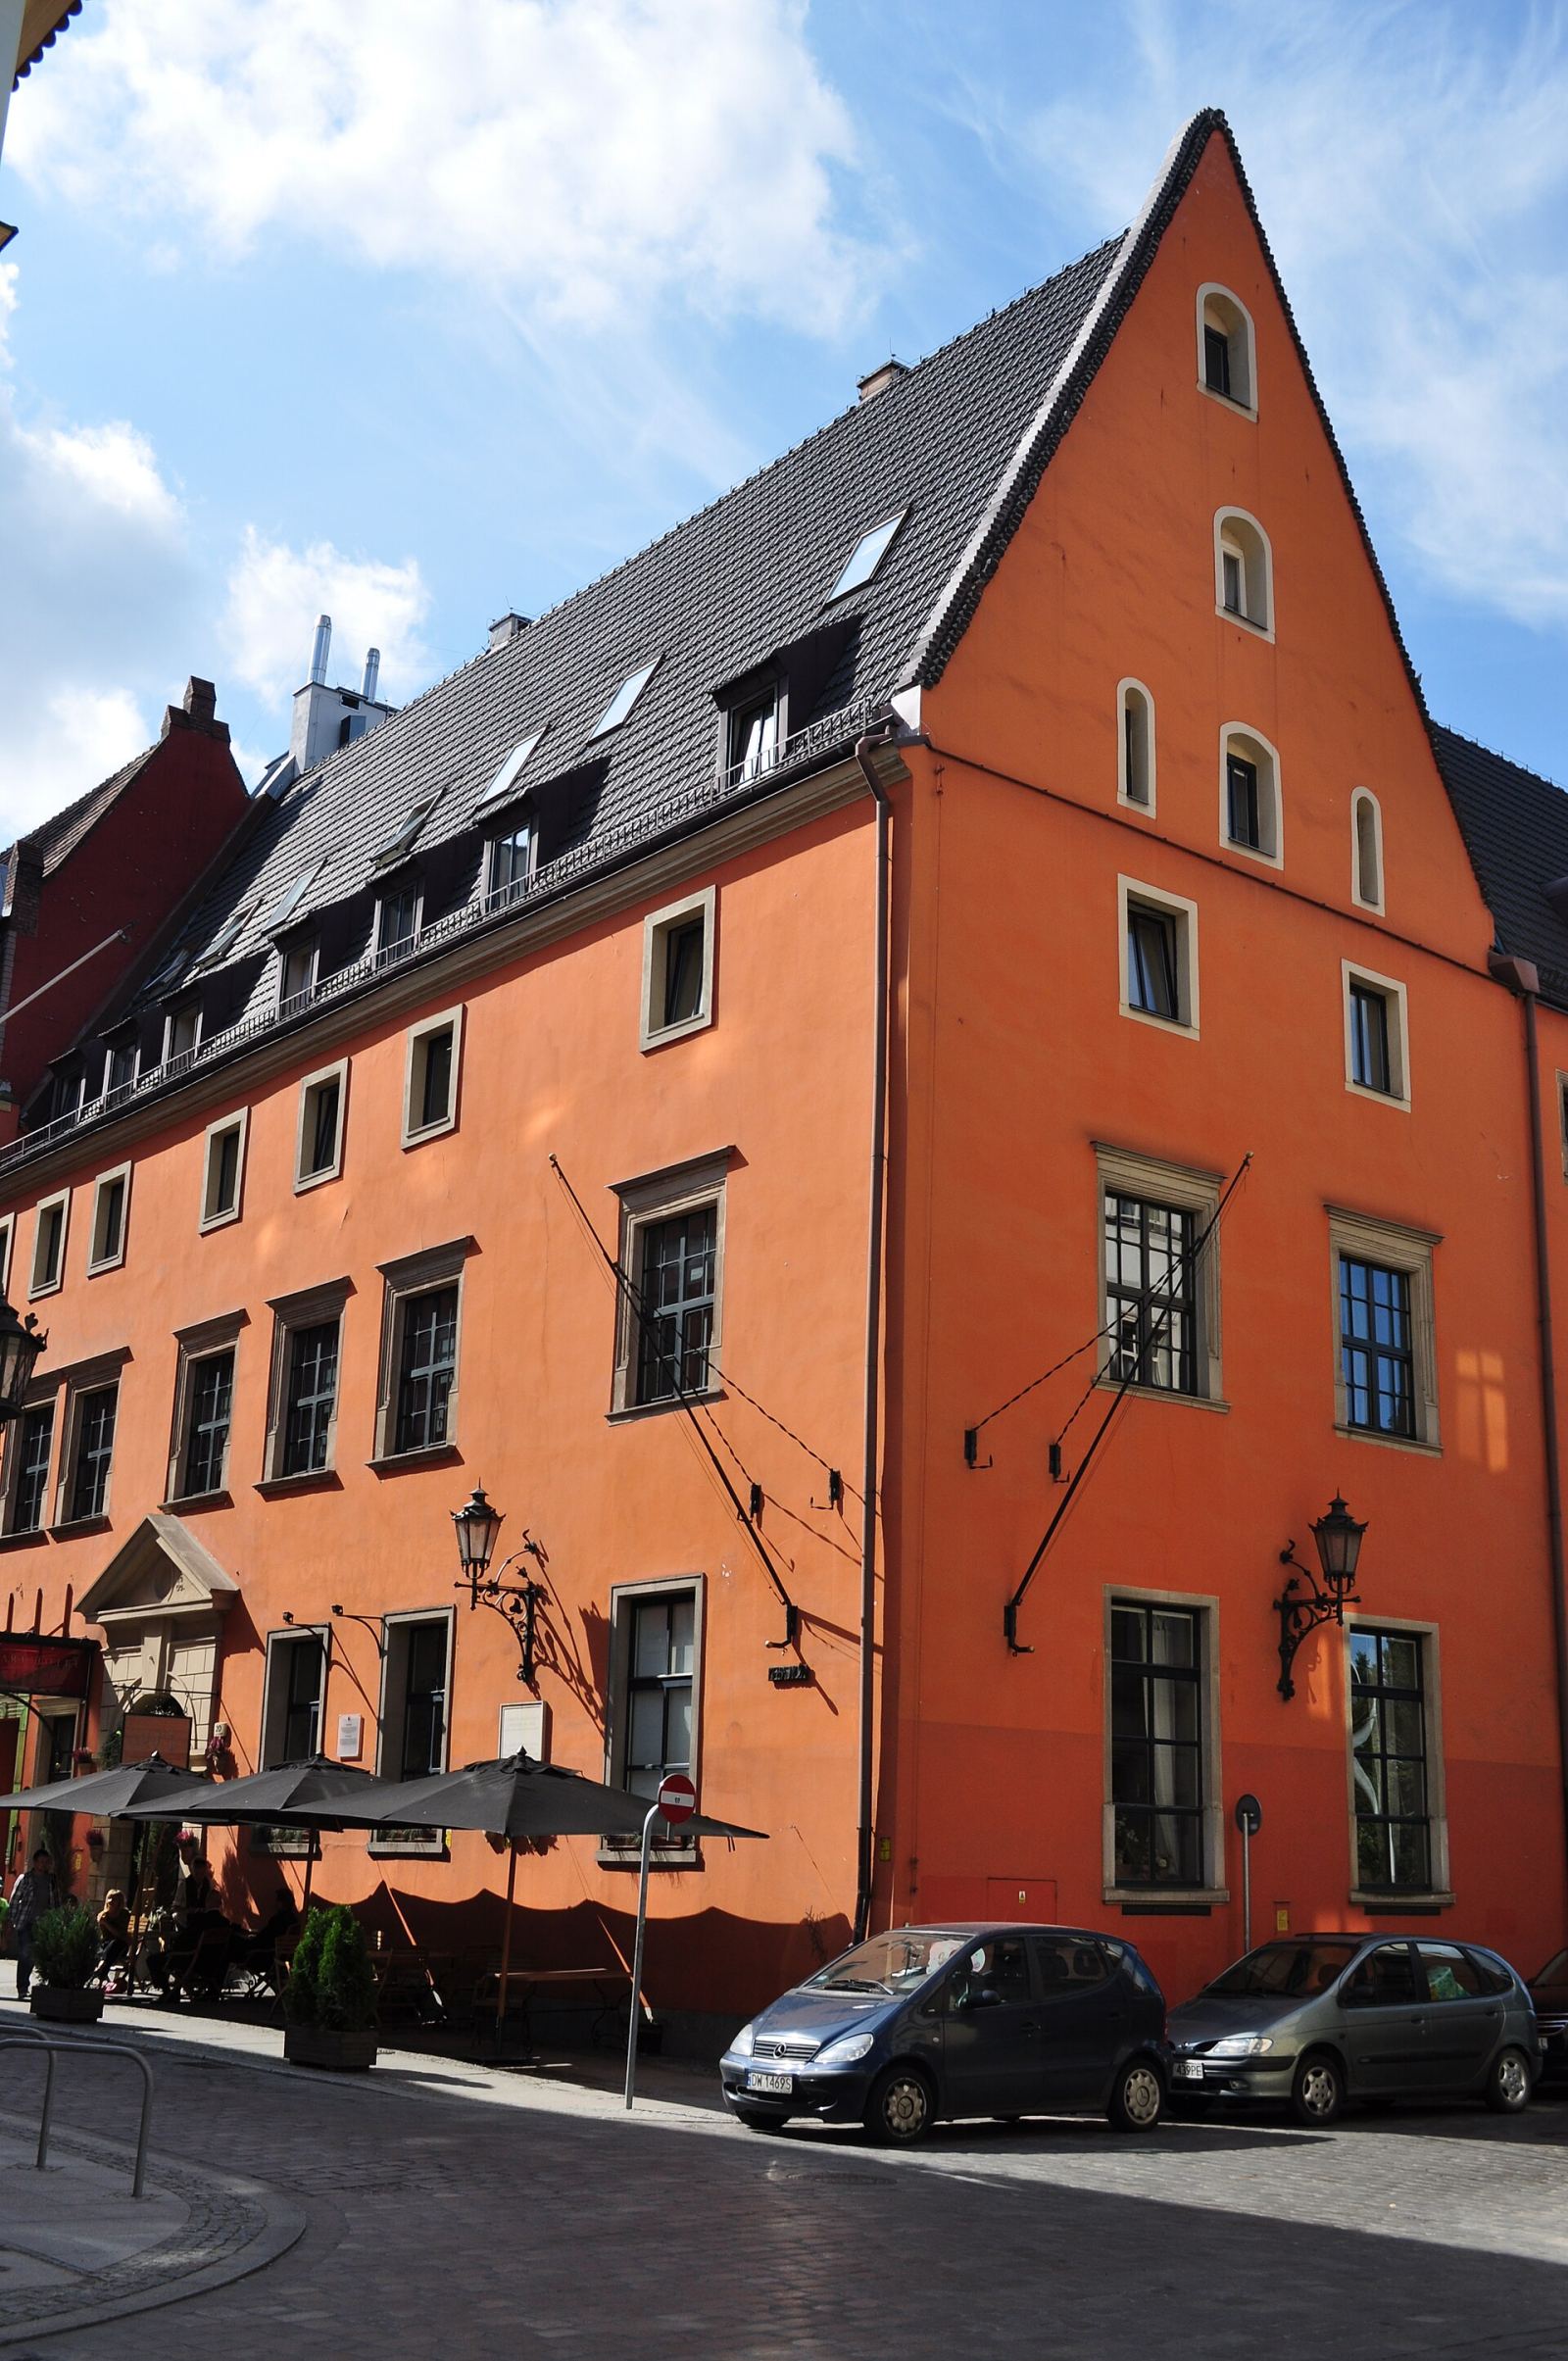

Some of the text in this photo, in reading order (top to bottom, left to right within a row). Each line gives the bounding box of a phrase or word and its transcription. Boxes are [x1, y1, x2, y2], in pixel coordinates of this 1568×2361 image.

[1176, 2064, 1201, 2076] 439PE
[752, 2074, 791, 2090] DW 1469S
